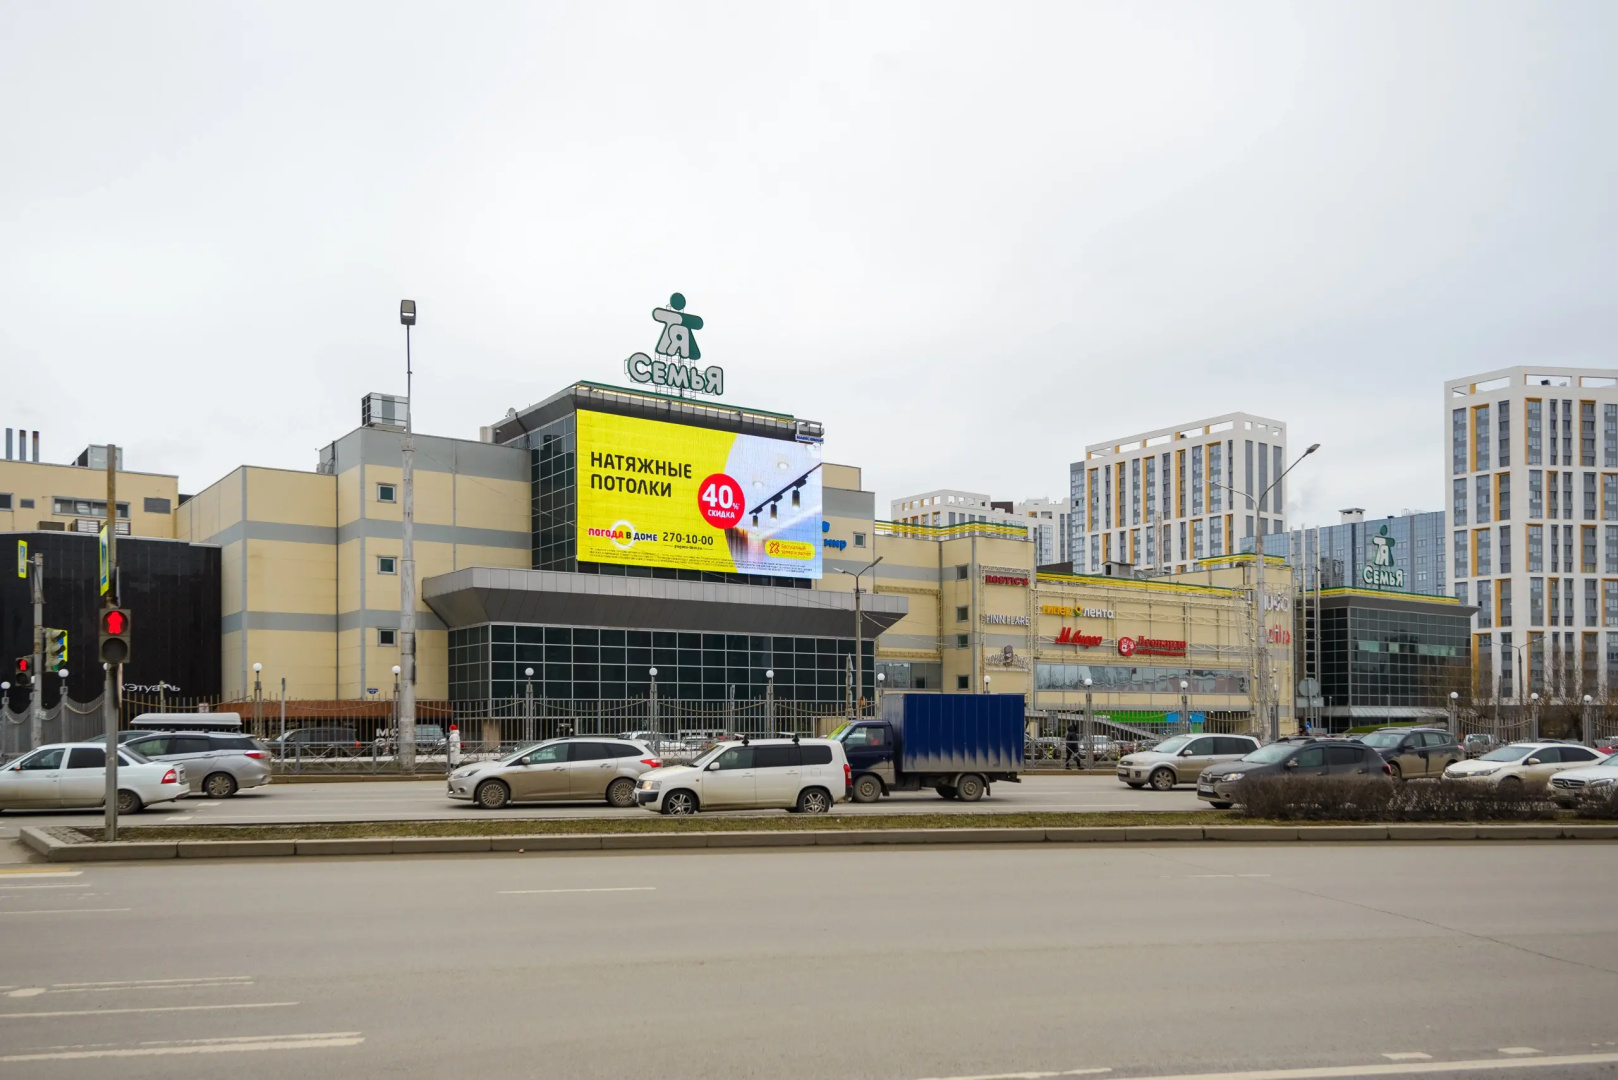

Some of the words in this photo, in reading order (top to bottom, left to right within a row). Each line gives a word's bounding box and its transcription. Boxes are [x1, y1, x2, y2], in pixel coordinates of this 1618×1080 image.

[591, 451, 692, 479] НАТЯЖНЫЕ
[591, 473, 672, 498] ПОТОЛКИ
[707, 509, 736, 519] СКИДКА
[588, 528, 624, 540] ПОГОДА
[633, 532, 658, 542] ДОМЕ
[662, 532, 714, 546] 270-10-00
[985, 574, 1029, 587] ROSTIC'S
[1042, 605, 1073, 618] гипер
[1083, 607, 1114, 619] лента
[985, 613, 1004, 625] FINN
[1006, 615, 1030, 627] FLARE
